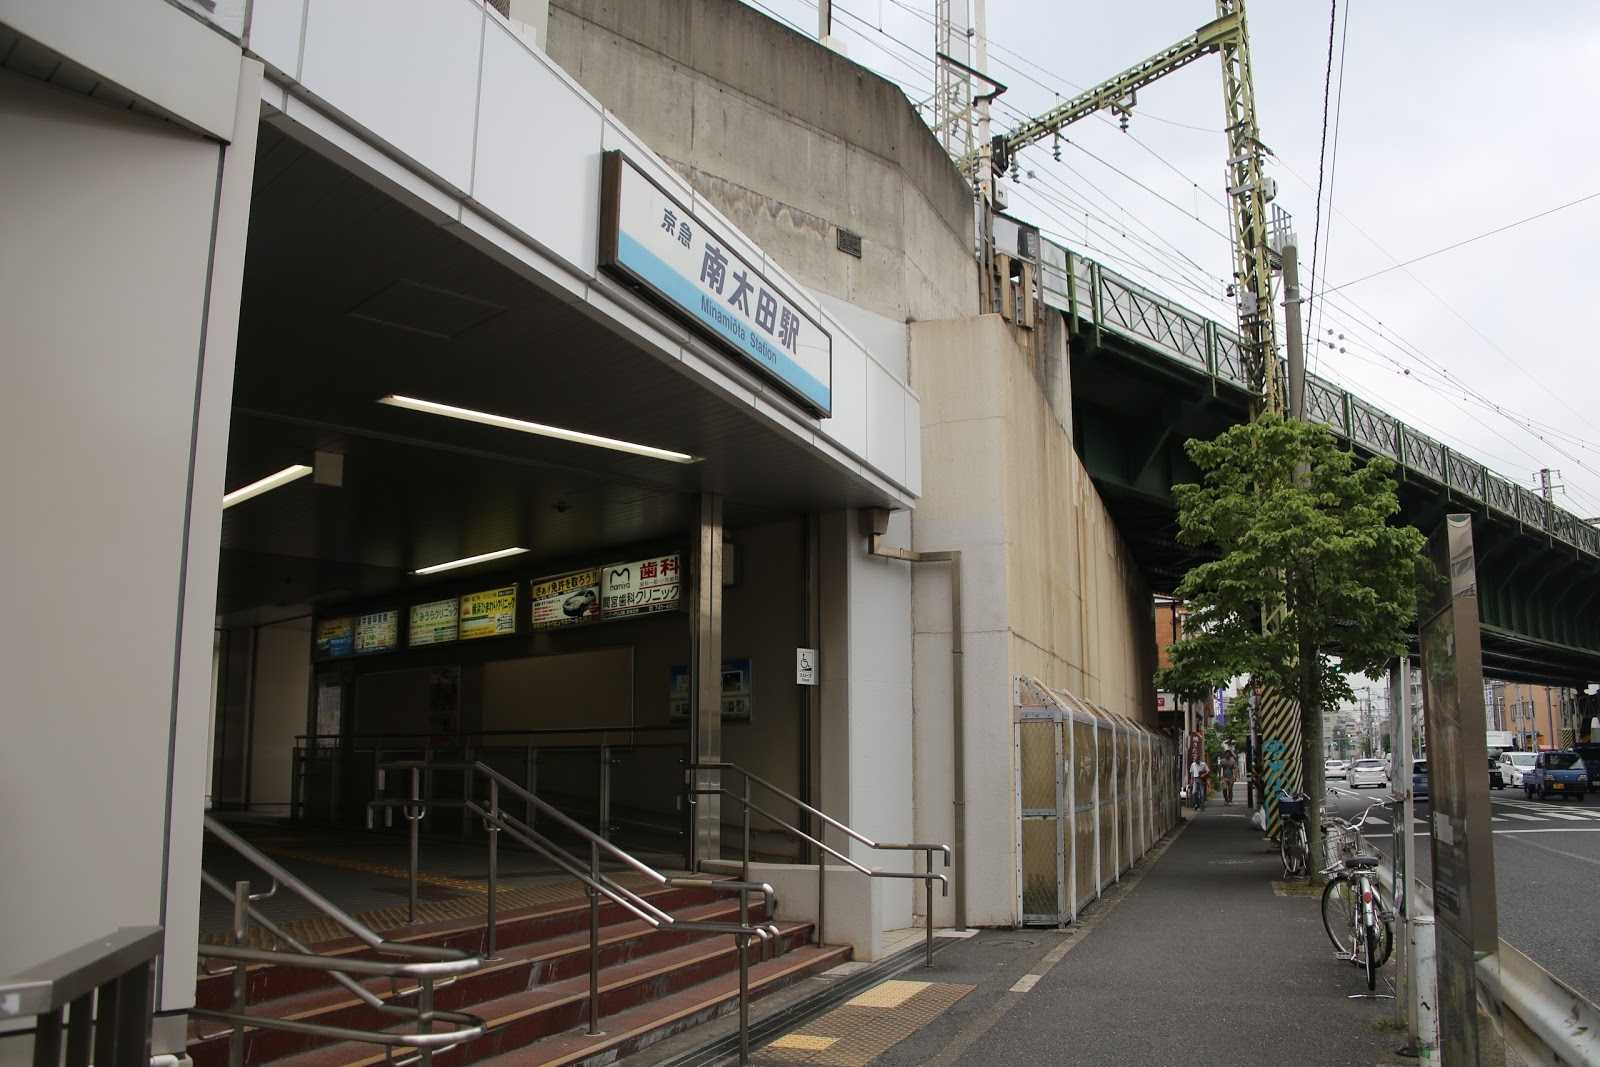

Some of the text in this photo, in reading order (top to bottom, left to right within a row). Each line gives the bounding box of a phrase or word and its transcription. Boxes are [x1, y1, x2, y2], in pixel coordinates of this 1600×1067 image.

[661, 207, 694, 249] 京急
[700, 242, 801, 355] 南太田駅
[750, 332, 778, 364] Station
[640, 556, 680, 580] 歯科
[602, 585, 681, 608] 間宮歯科クリニック
